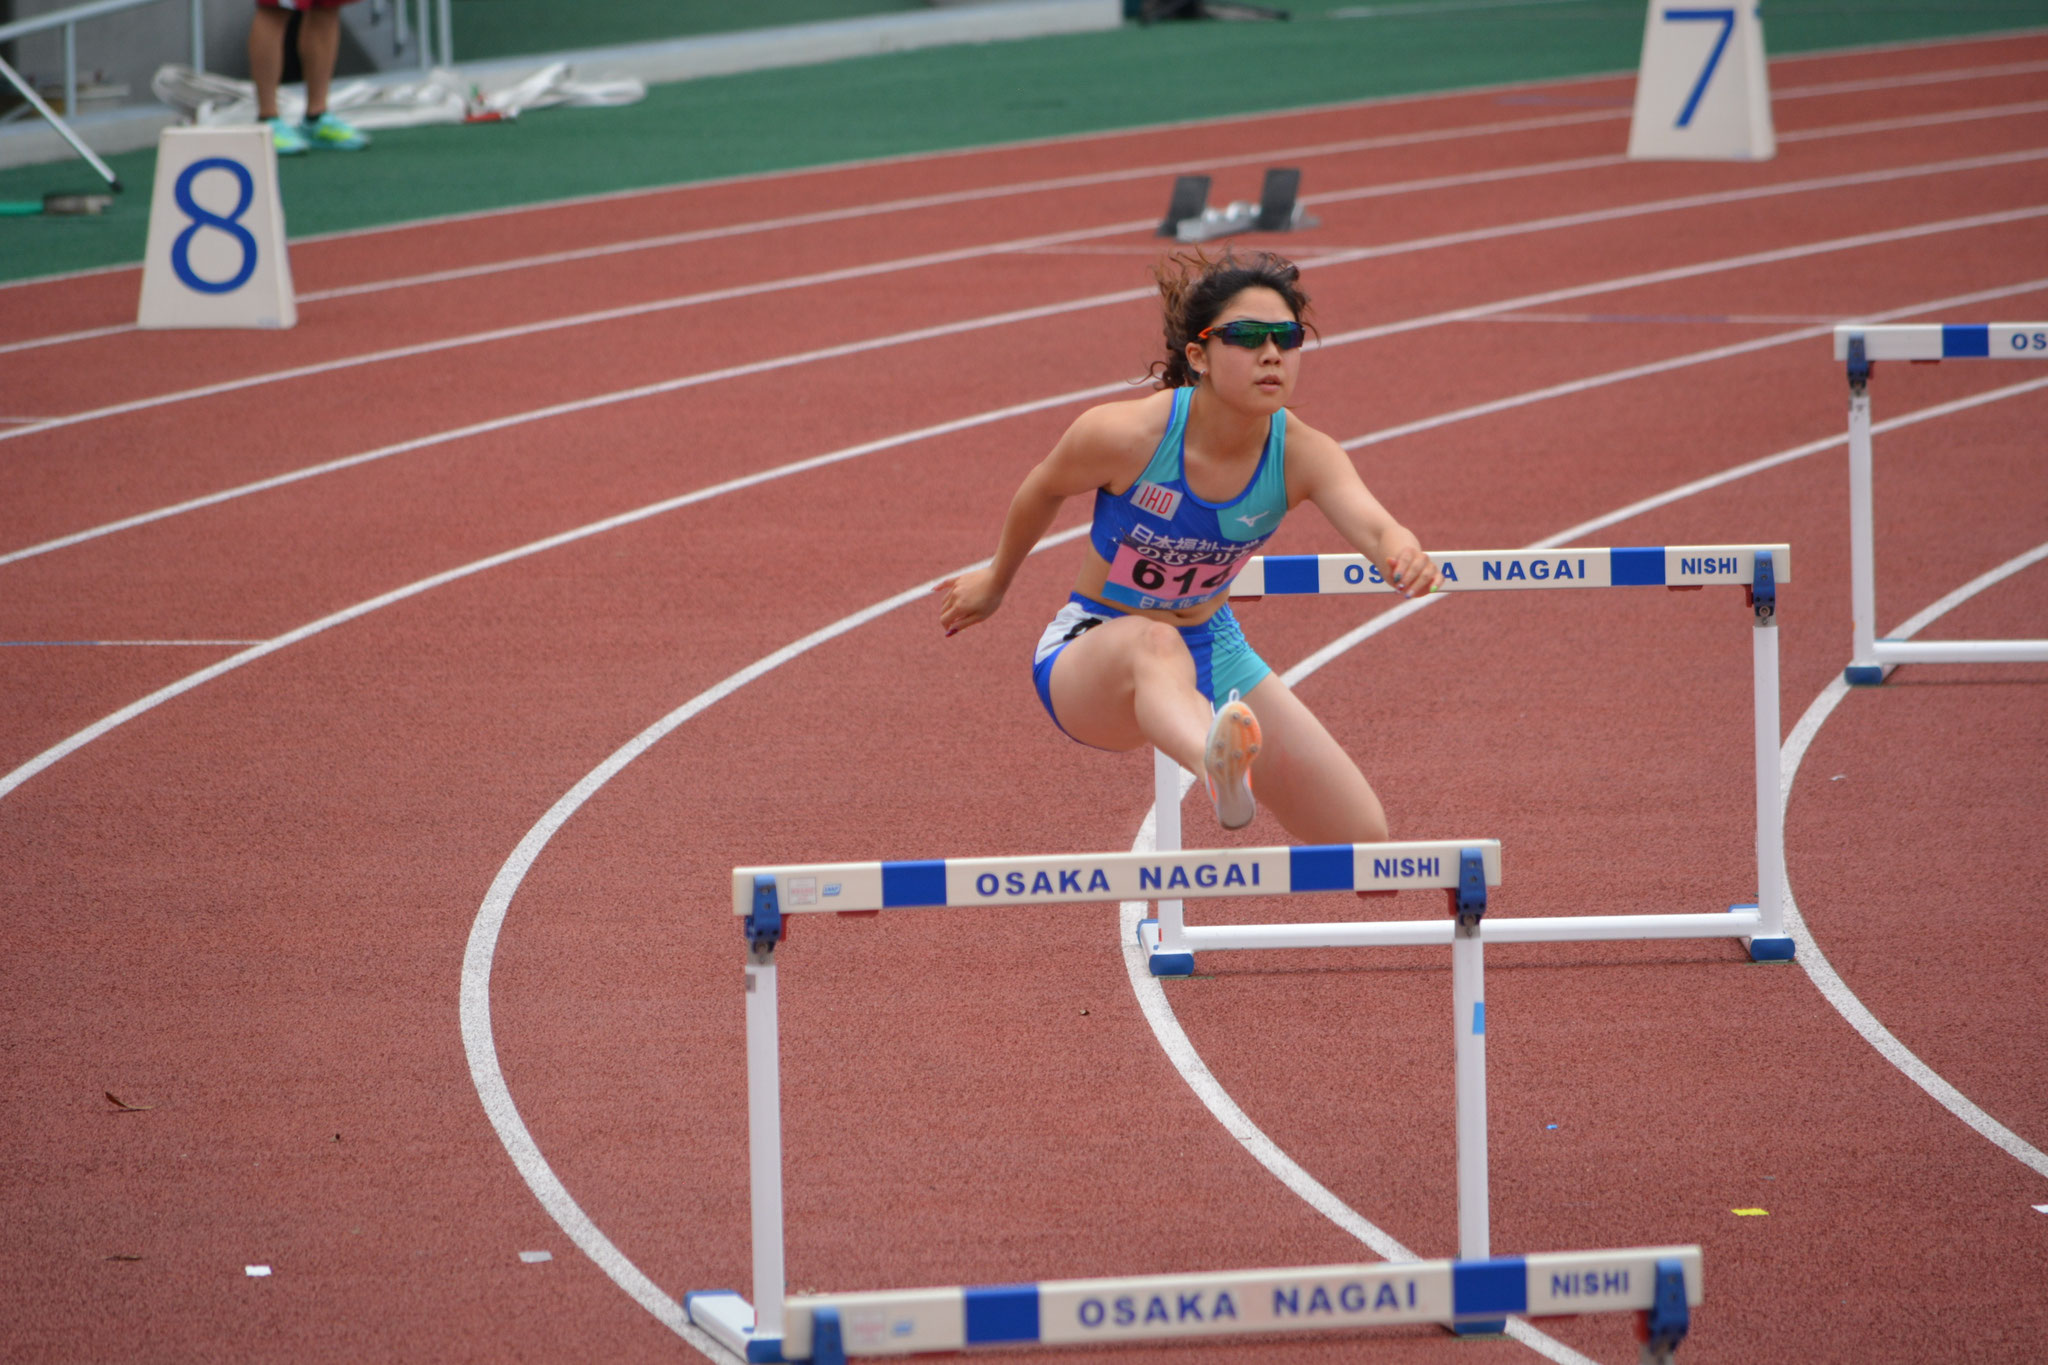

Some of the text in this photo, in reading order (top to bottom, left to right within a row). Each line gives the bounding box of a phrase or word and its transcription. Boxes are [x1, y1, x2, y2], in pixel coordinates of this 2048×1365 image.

[1663, 7, 1736, 128] 7
[170, 156, 259, 295] 8
[1132, 559, 1233, 596] 614
[1343, 557, 1738, 585] OSA NAGAI NISHI
[976, 858, 1440, 896] OSAKA NAGAI NISHI
[1078, 1272, 1629, 1327] OSAKA NAGAI NISHI
